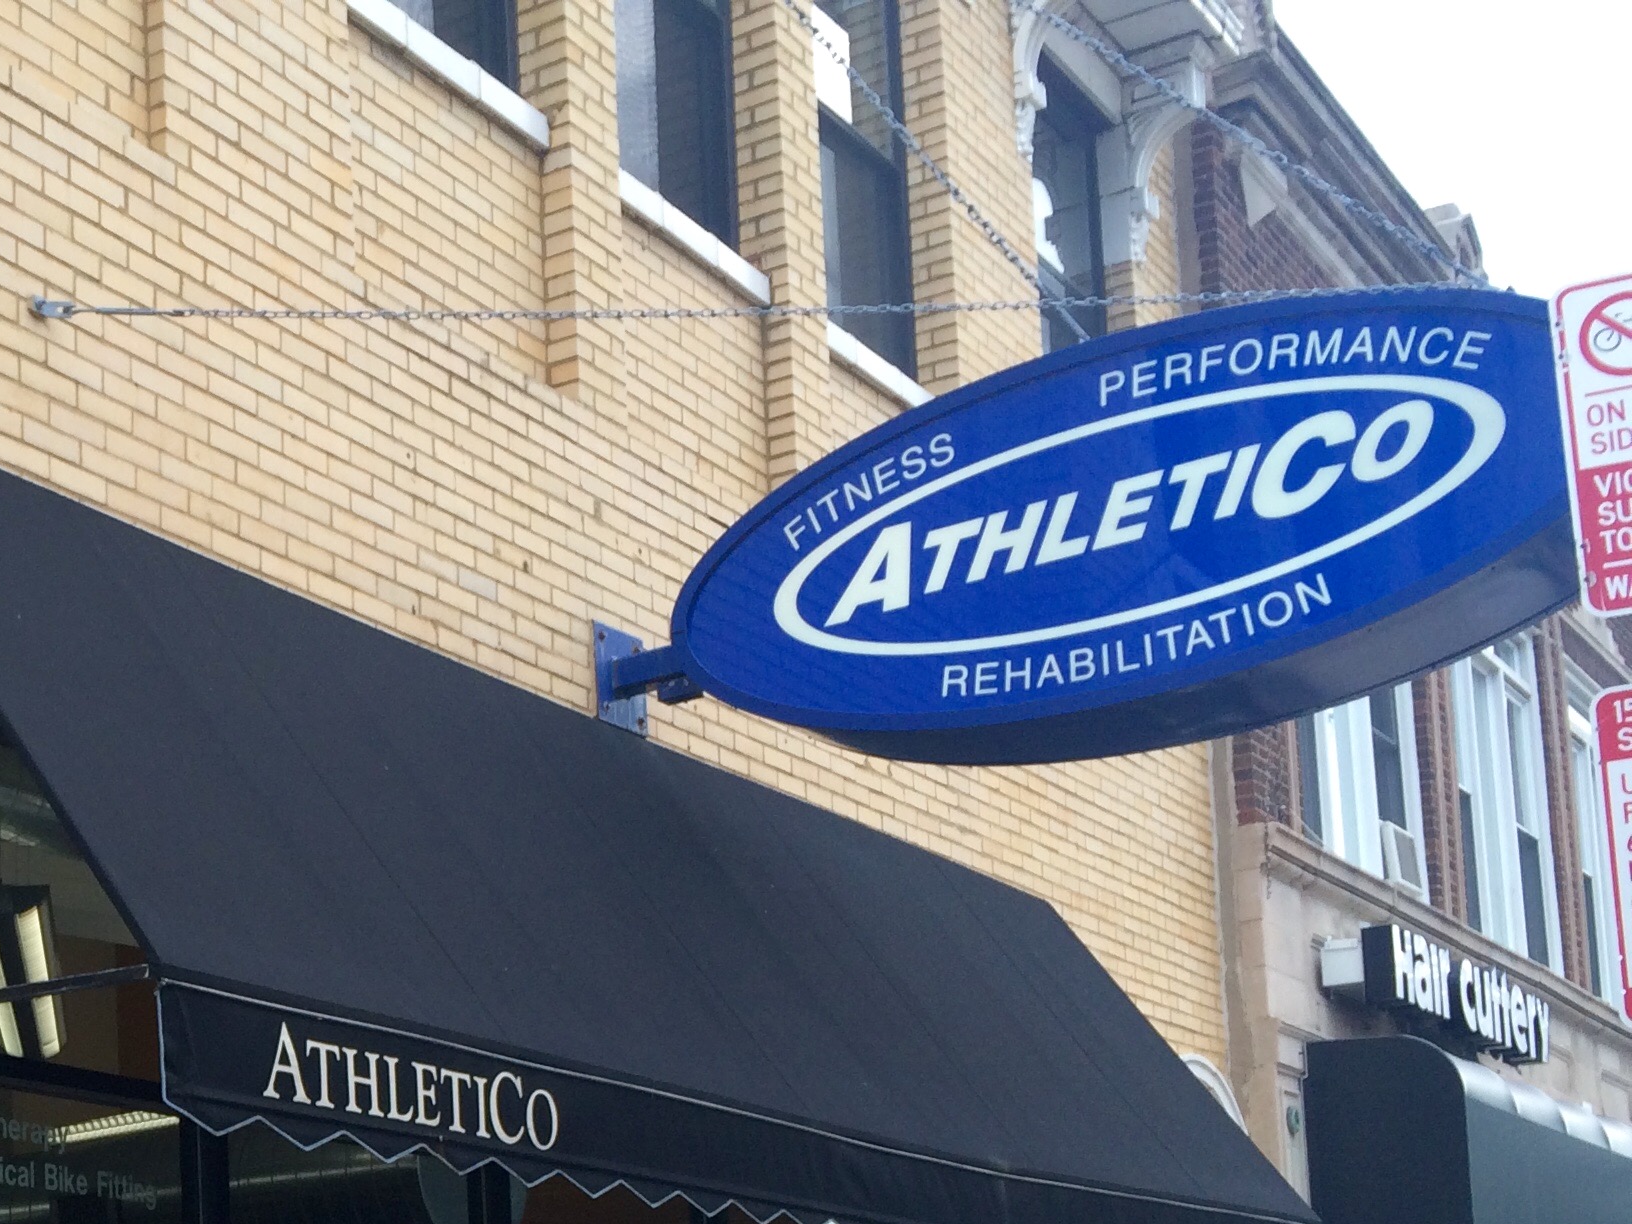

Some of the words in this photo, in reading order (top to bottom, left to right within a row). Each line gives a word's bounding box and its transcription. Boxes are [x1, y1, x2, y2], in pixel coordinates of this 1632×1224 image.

[1098, 326, 1492, 407] PERFORMANCE
[1587, 399, 1626, 427] ON
[782, 432, 956, 551] FITNESS
[825, 399, 1434, 628] ATHLETICO
[942, 572, 1333, 698] REHABILITATION
[1392, 924, 1451, 1020] Hair
[263, 1021, 558, 1151] ATHLETICO
[44, 1163, 88, 1196] Bike
[97, 1171, 157, 1210] Fitting
